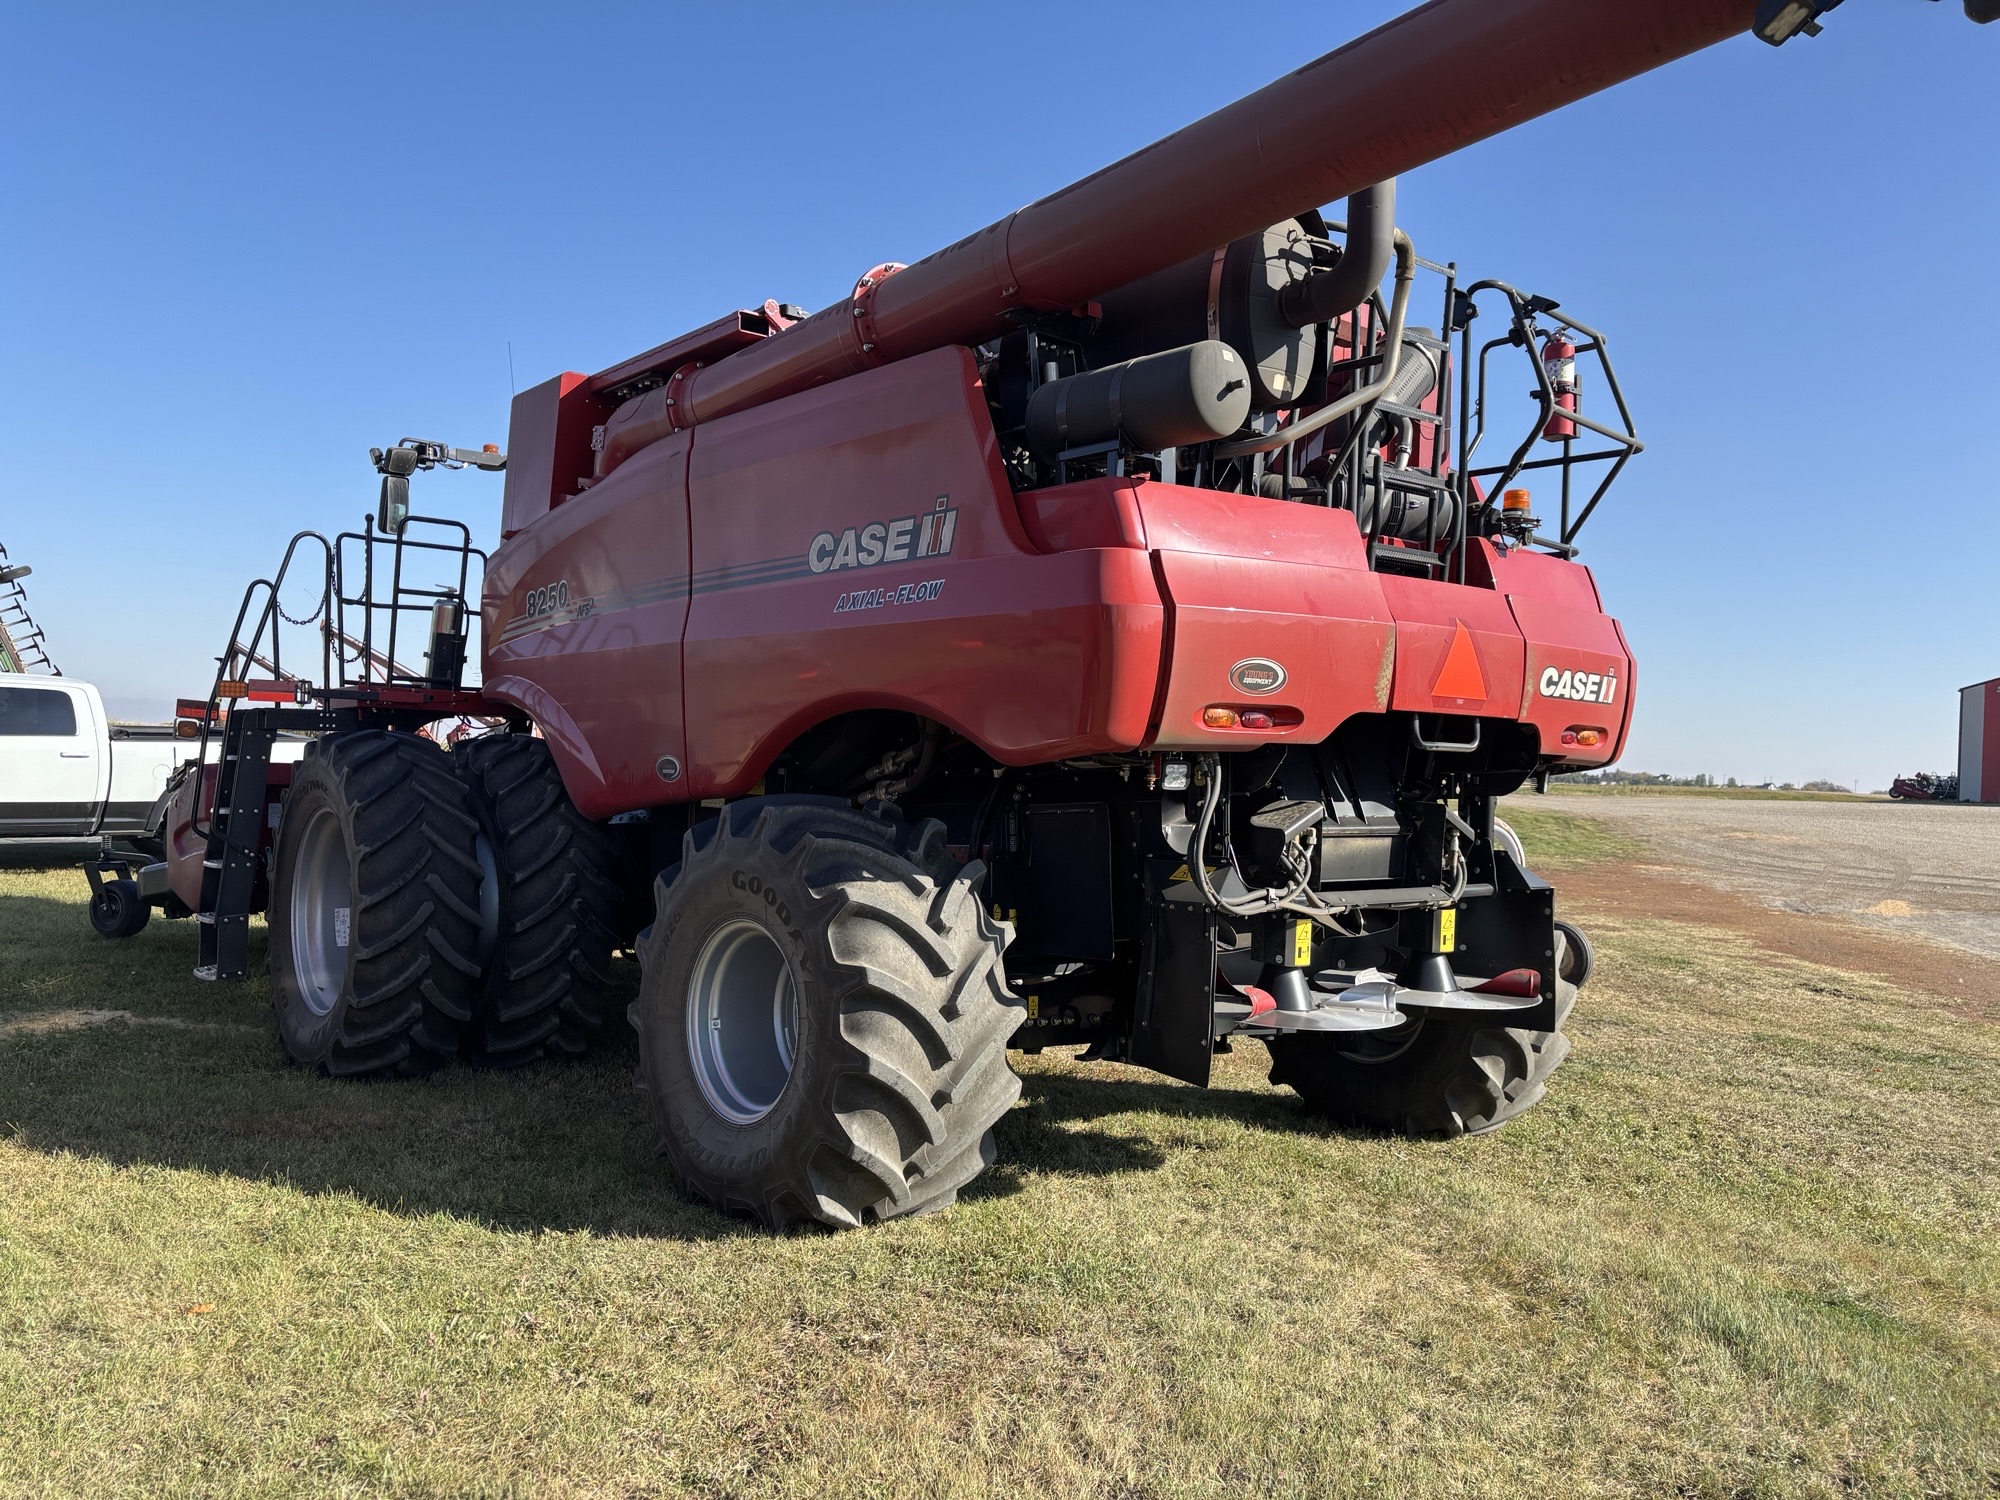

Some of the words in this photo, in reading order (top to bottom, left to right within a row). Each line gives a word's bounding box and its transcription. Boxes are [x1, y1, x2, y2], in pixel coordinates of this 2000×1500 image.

[808, 518, 915, 573] CASE
[526, 580, 568, 619] 8250
[833, 578, 945, 614] AXIAL-FLOW
[1539, 666, 1601, 702] CASE
[731, 868, 818, 1079] GOODYEAR
